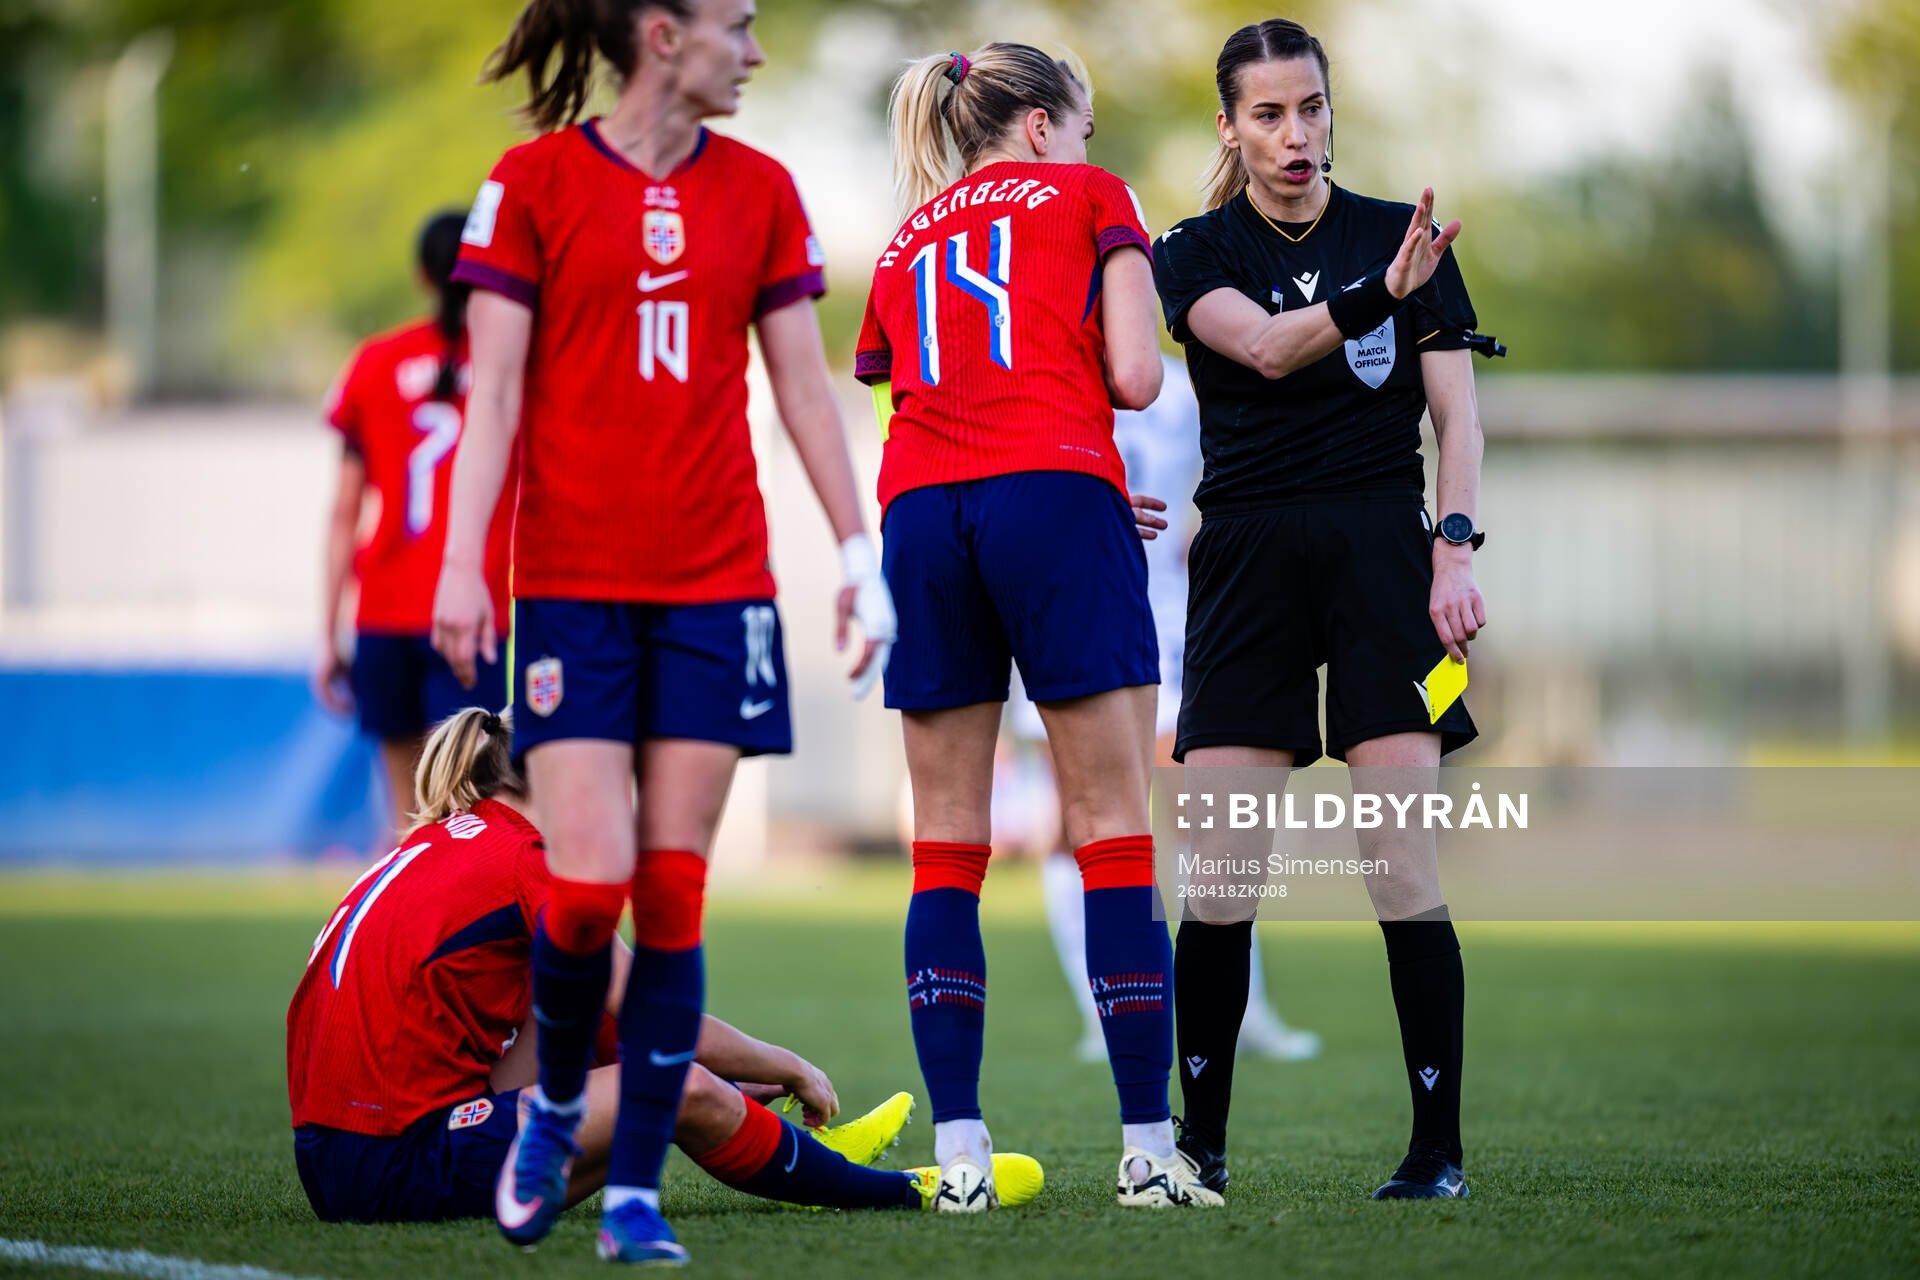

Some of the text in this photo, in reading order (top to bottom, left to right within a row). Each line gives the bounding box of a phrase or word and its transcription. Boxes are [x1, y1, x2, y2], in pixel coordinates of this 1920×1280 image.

[879, 178, 1060, 268] HEGERBERG
[636, 299, 689, 383] 10
[906, 215, 1012, 387] 14
[1354, 357, 1392, 369] OFFICIAL
[1357, 346, 1387, 358] MATCH
